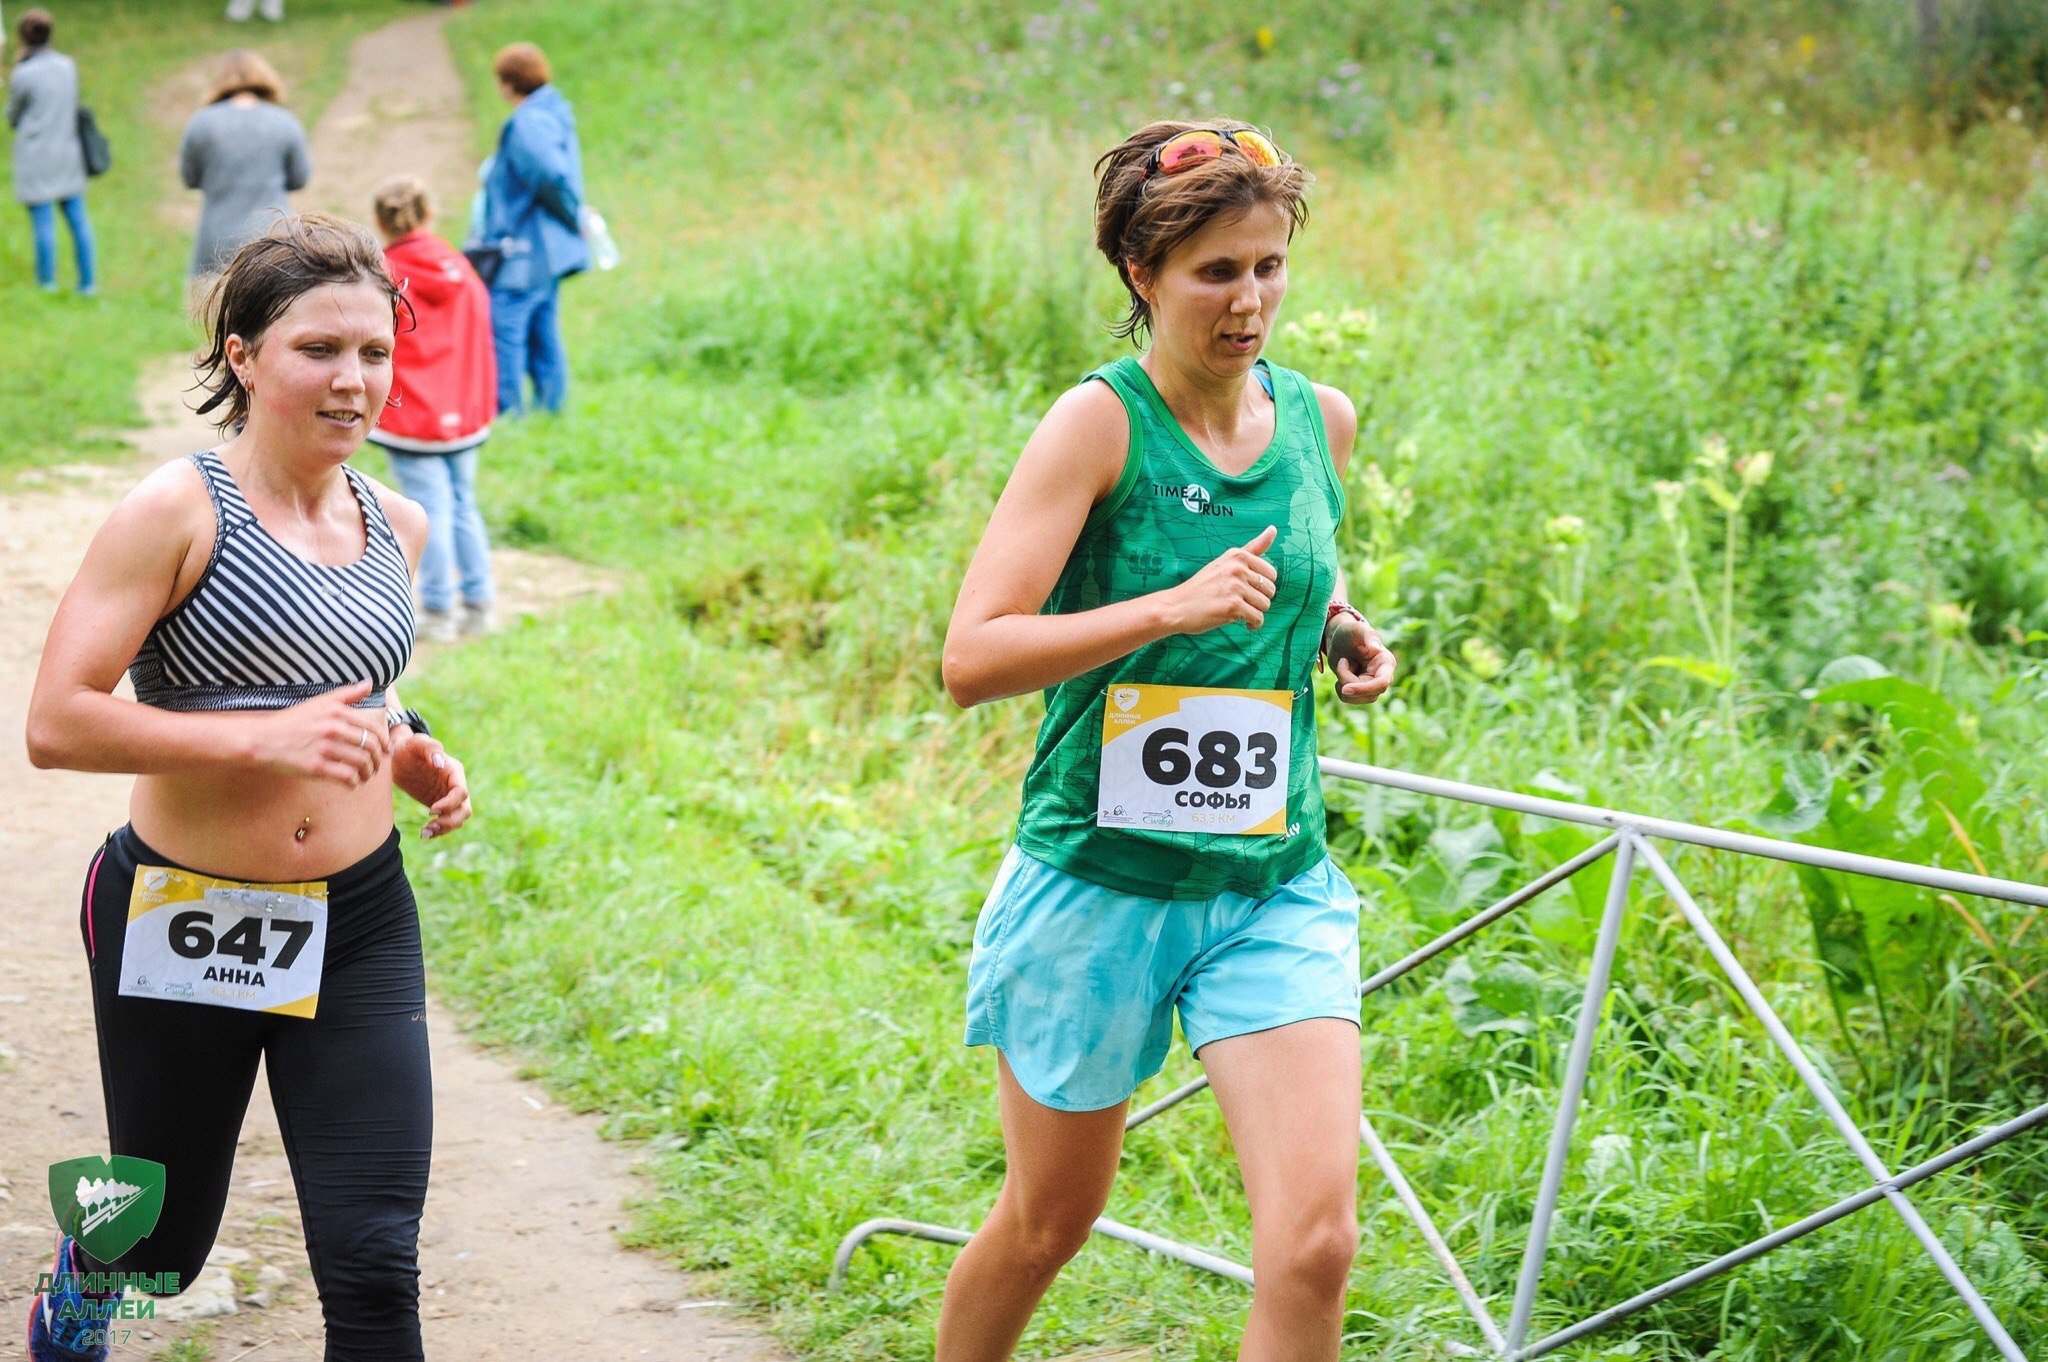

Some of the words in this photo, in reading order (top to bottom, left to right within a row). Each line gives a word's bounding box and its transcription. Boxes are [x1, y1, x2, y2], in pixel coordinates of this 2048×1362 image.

[1153, 484, 1189, 498] TIME
[1188, 486, 1208, 512] 4
[1202, 504, 1234, 517] RUN
[1142, 727, 1277, 789] 683
[1174, 791, 1251, 809] СОФЬЯ
[168, 910, 313, 970] 647
[203, 966, 265, 987] АННА
